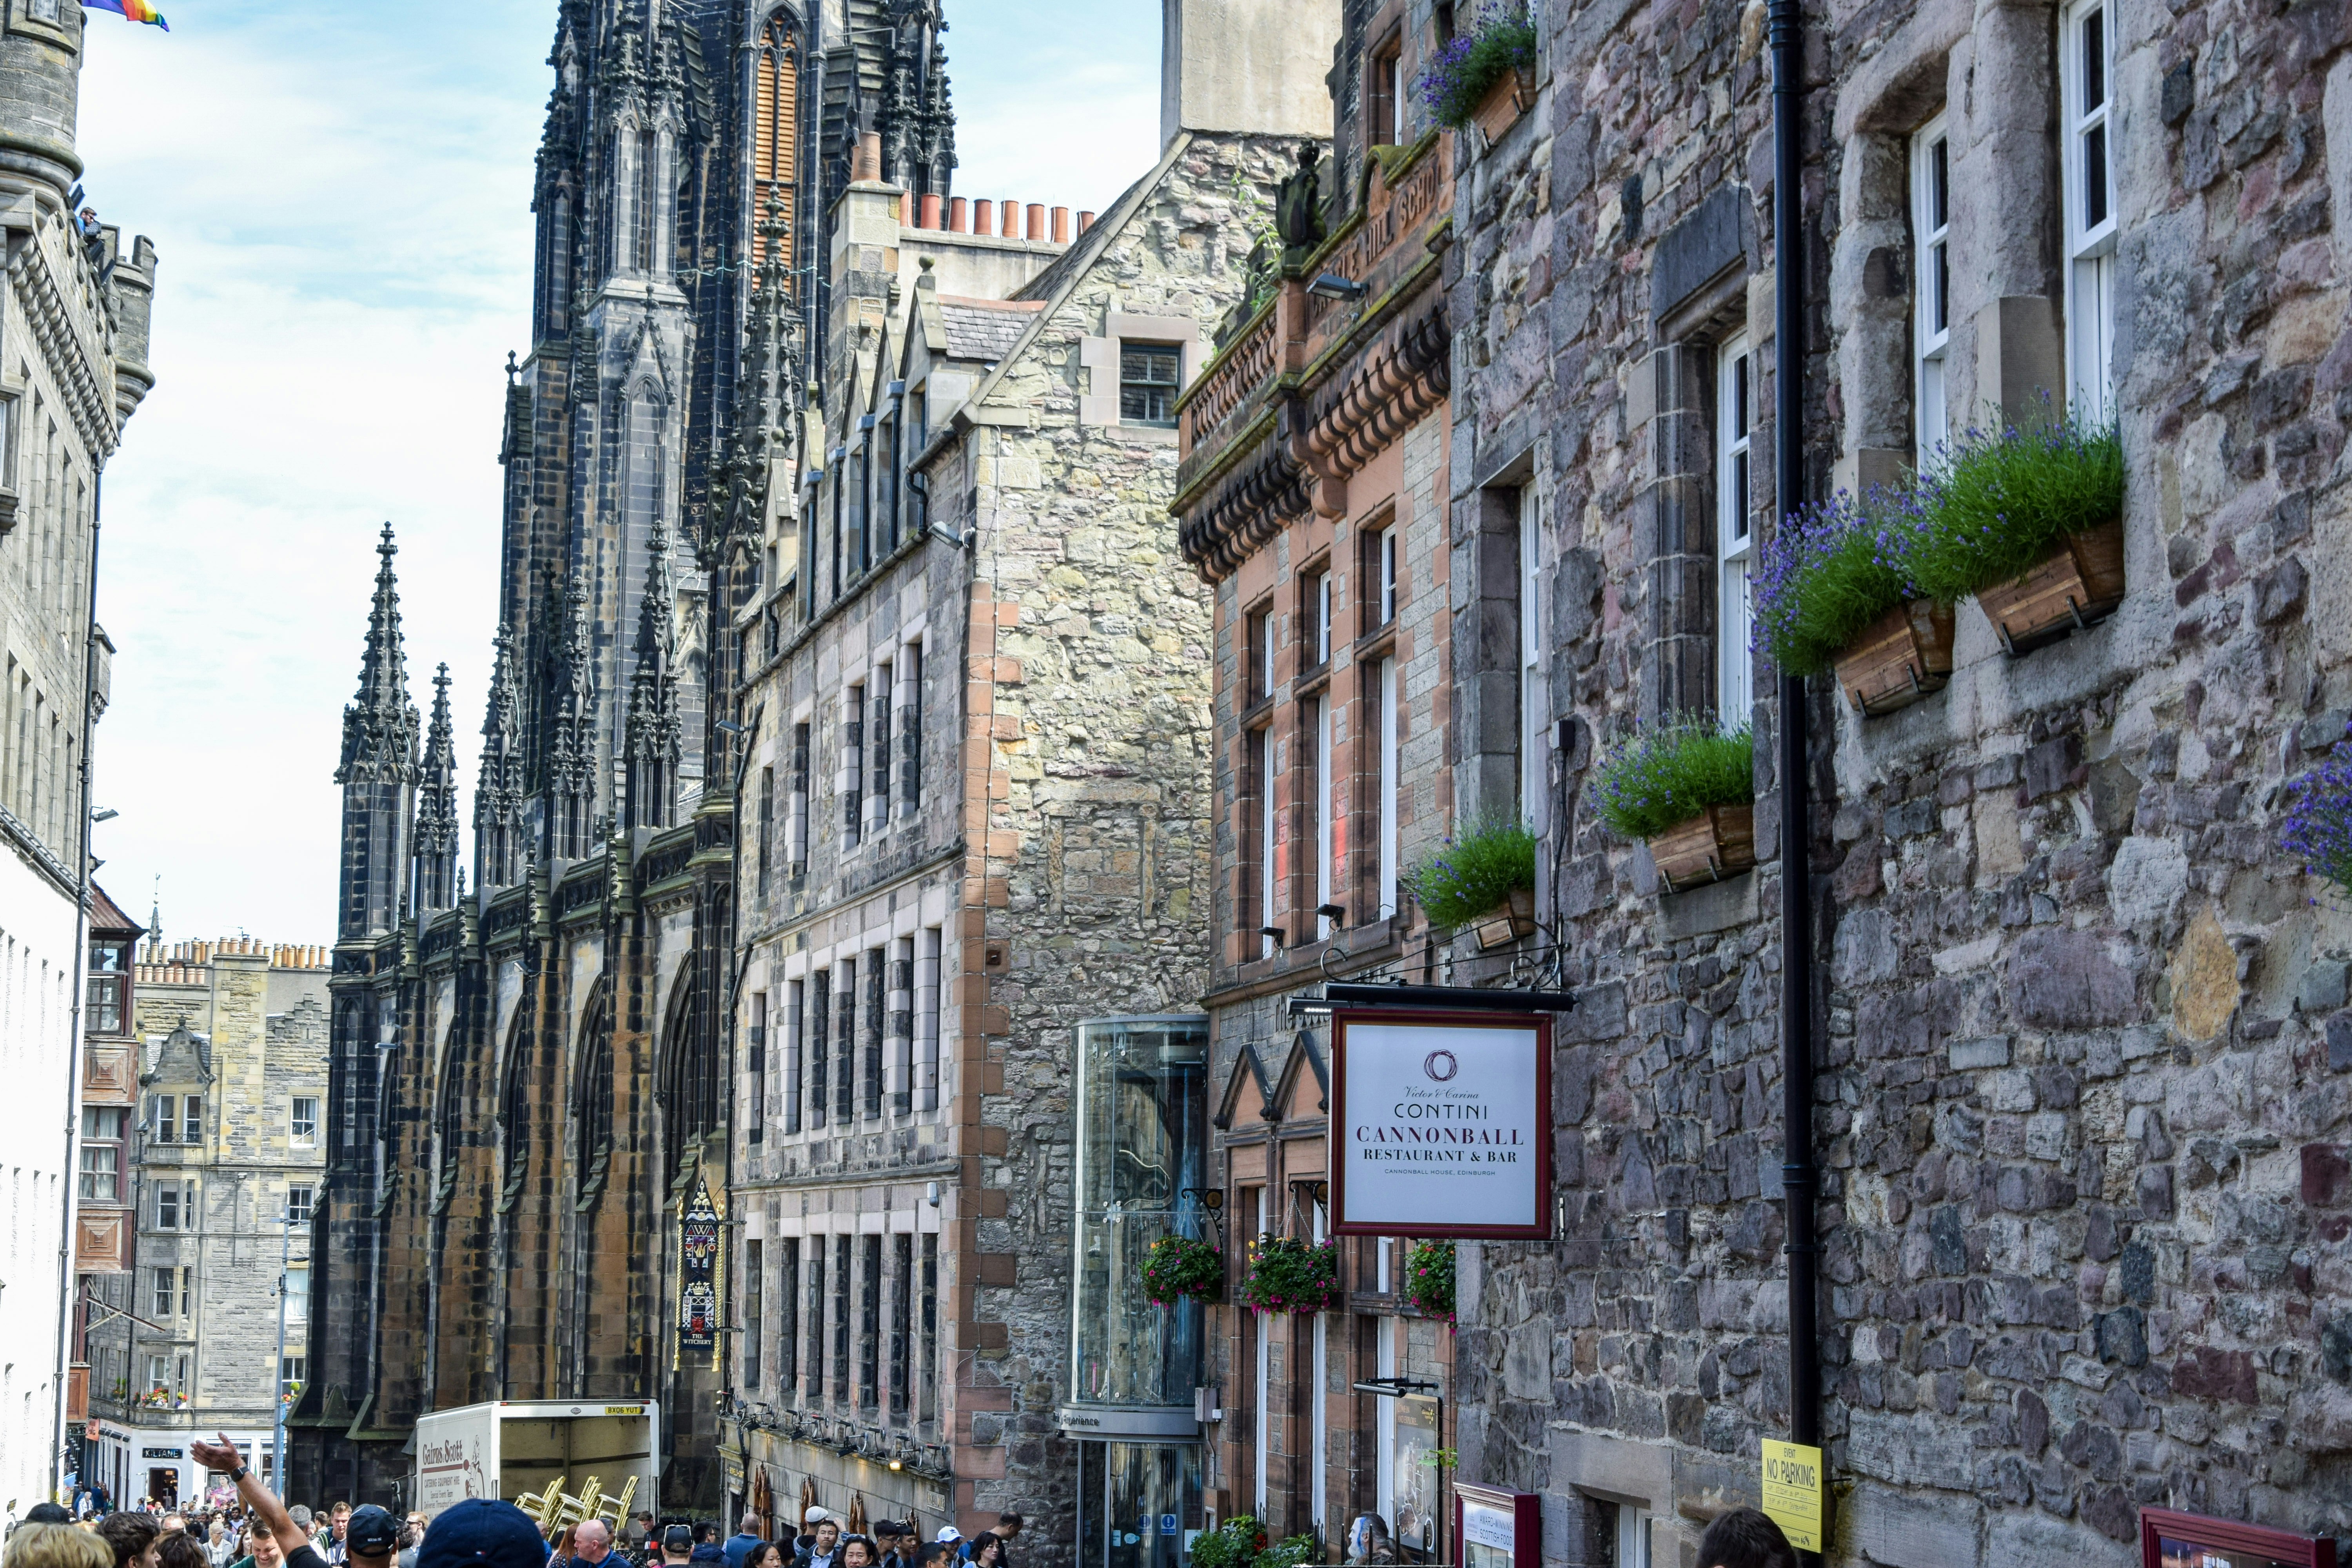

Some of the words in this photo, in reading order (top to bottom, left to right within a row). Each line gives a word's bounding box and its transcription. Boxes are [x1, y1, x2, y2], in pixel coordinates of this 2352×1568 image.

[1365, 211, 1394, 266] HILL
[1399, 163, 1442, 230] SCHO
[1404, 1086, 1432, 1098] Victor
[1435, 1089, 1445, 1098] &
[1445, 1087, 1479, 1099] Carina
[1394, 1103, 1487, 1120] CONTINI
[1356, 1125, 1524, 1145] CANNONBALL
[1363, 1149, 1464, 1162] RESTAURANT
[1470, 1151, 1481, 1162] &
[1487, 1151, 1517, 1163] BAR
[693, 1225, 709, 1235] W
[445, 1439, 463, 1463] Scott
[1784, 1447, 1795, 1459] EVENT
[1767, 1457, 1778, 1479] NO
[1781, 1460, 1815, 1488] PARKING
[425, 1478, 437, 1488] CATERING
[1479, 1515, 1512, 1532] AWARD-WINNING
[1480, 1528, 1499, 1543] SCOTTISH
[1501, 1534, 1512, 1546] FOOD
